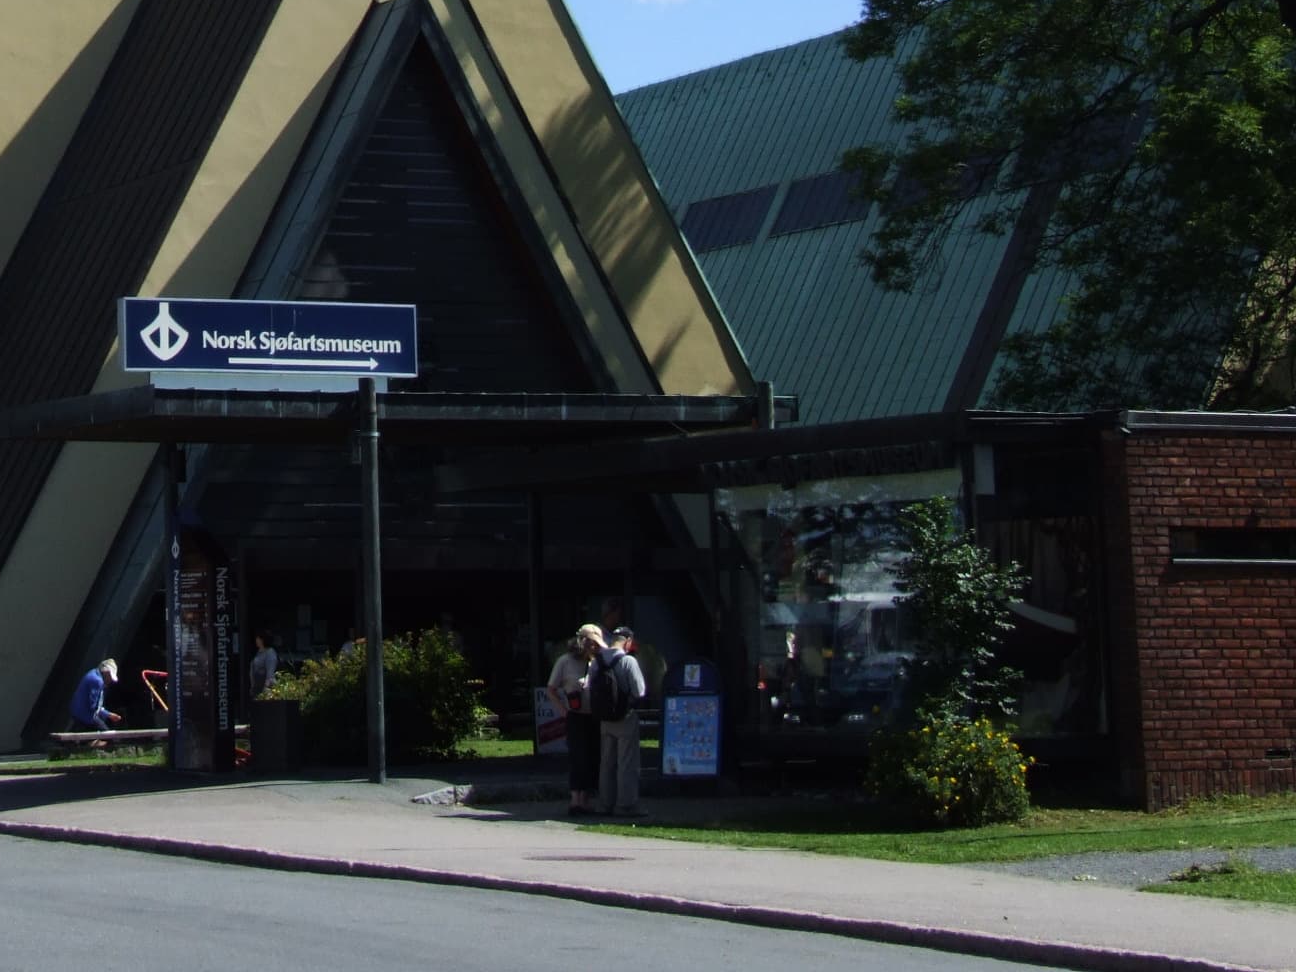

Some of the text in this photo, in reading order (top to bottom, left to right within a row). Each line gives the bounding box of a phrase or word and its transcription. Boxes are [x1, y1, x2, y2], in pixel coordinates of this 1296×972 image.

[202, 330, 402, 355] Norsk Sjøfartsmuseum
[215, 566, 231, 731] Norsk Sjøfartsmuseum
